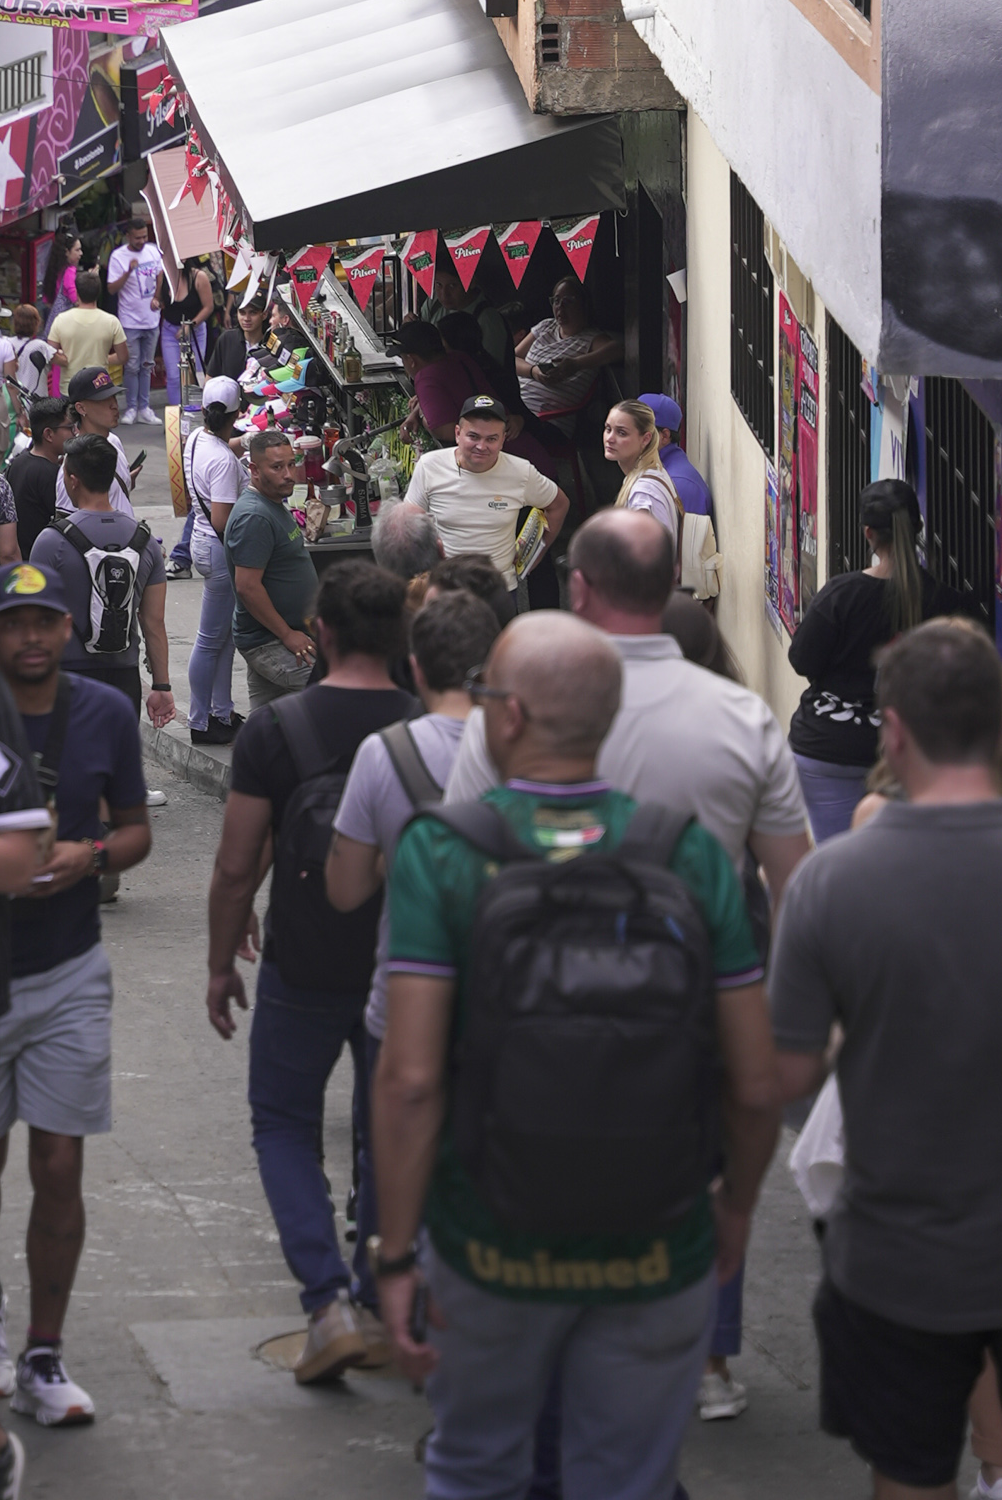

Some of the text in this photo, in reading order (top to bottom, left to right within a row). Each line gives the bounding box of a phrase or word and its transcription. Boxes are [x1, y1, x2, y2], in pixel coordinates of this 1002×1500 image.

[15, 14, 71, 29] CASERA
[566, 238, 593, 253] Pilsen
[454, 247, 482, 260] Pilsen
[350, 267, 377, 281] Pilsen
[465, 1237, 670, 1290] Unimed
